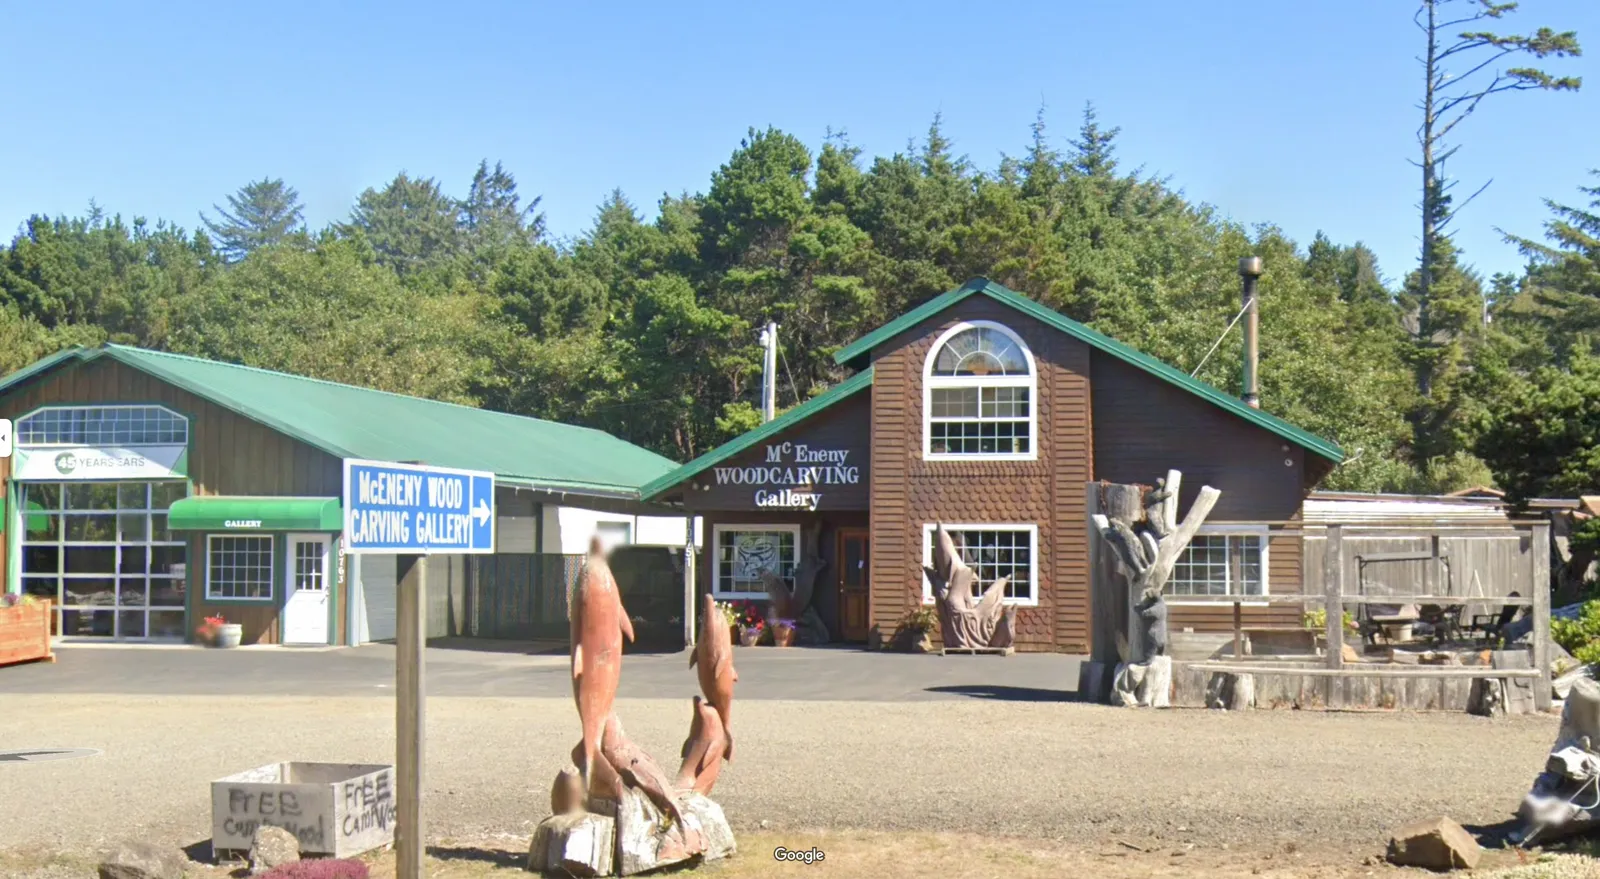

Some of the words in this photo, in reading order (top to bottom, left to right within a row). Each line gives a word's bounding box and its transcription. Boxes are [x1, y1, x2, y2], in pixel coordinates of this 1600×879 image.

[80, 458, 114, 468] YEARS
[794, 444, 849, 467] Eneny
[713, 466, 860, 485] WOODCARVING
[359, 470, 423, 507] McENENY
[427, 476, 463, 509] WOOD
[755, 488, 822, 512] Gallery
[224, 519, 262, 528] GALLERY
[350, 508, 410, 544] CARVING
[416, 511, 470, 544] GALLERY
